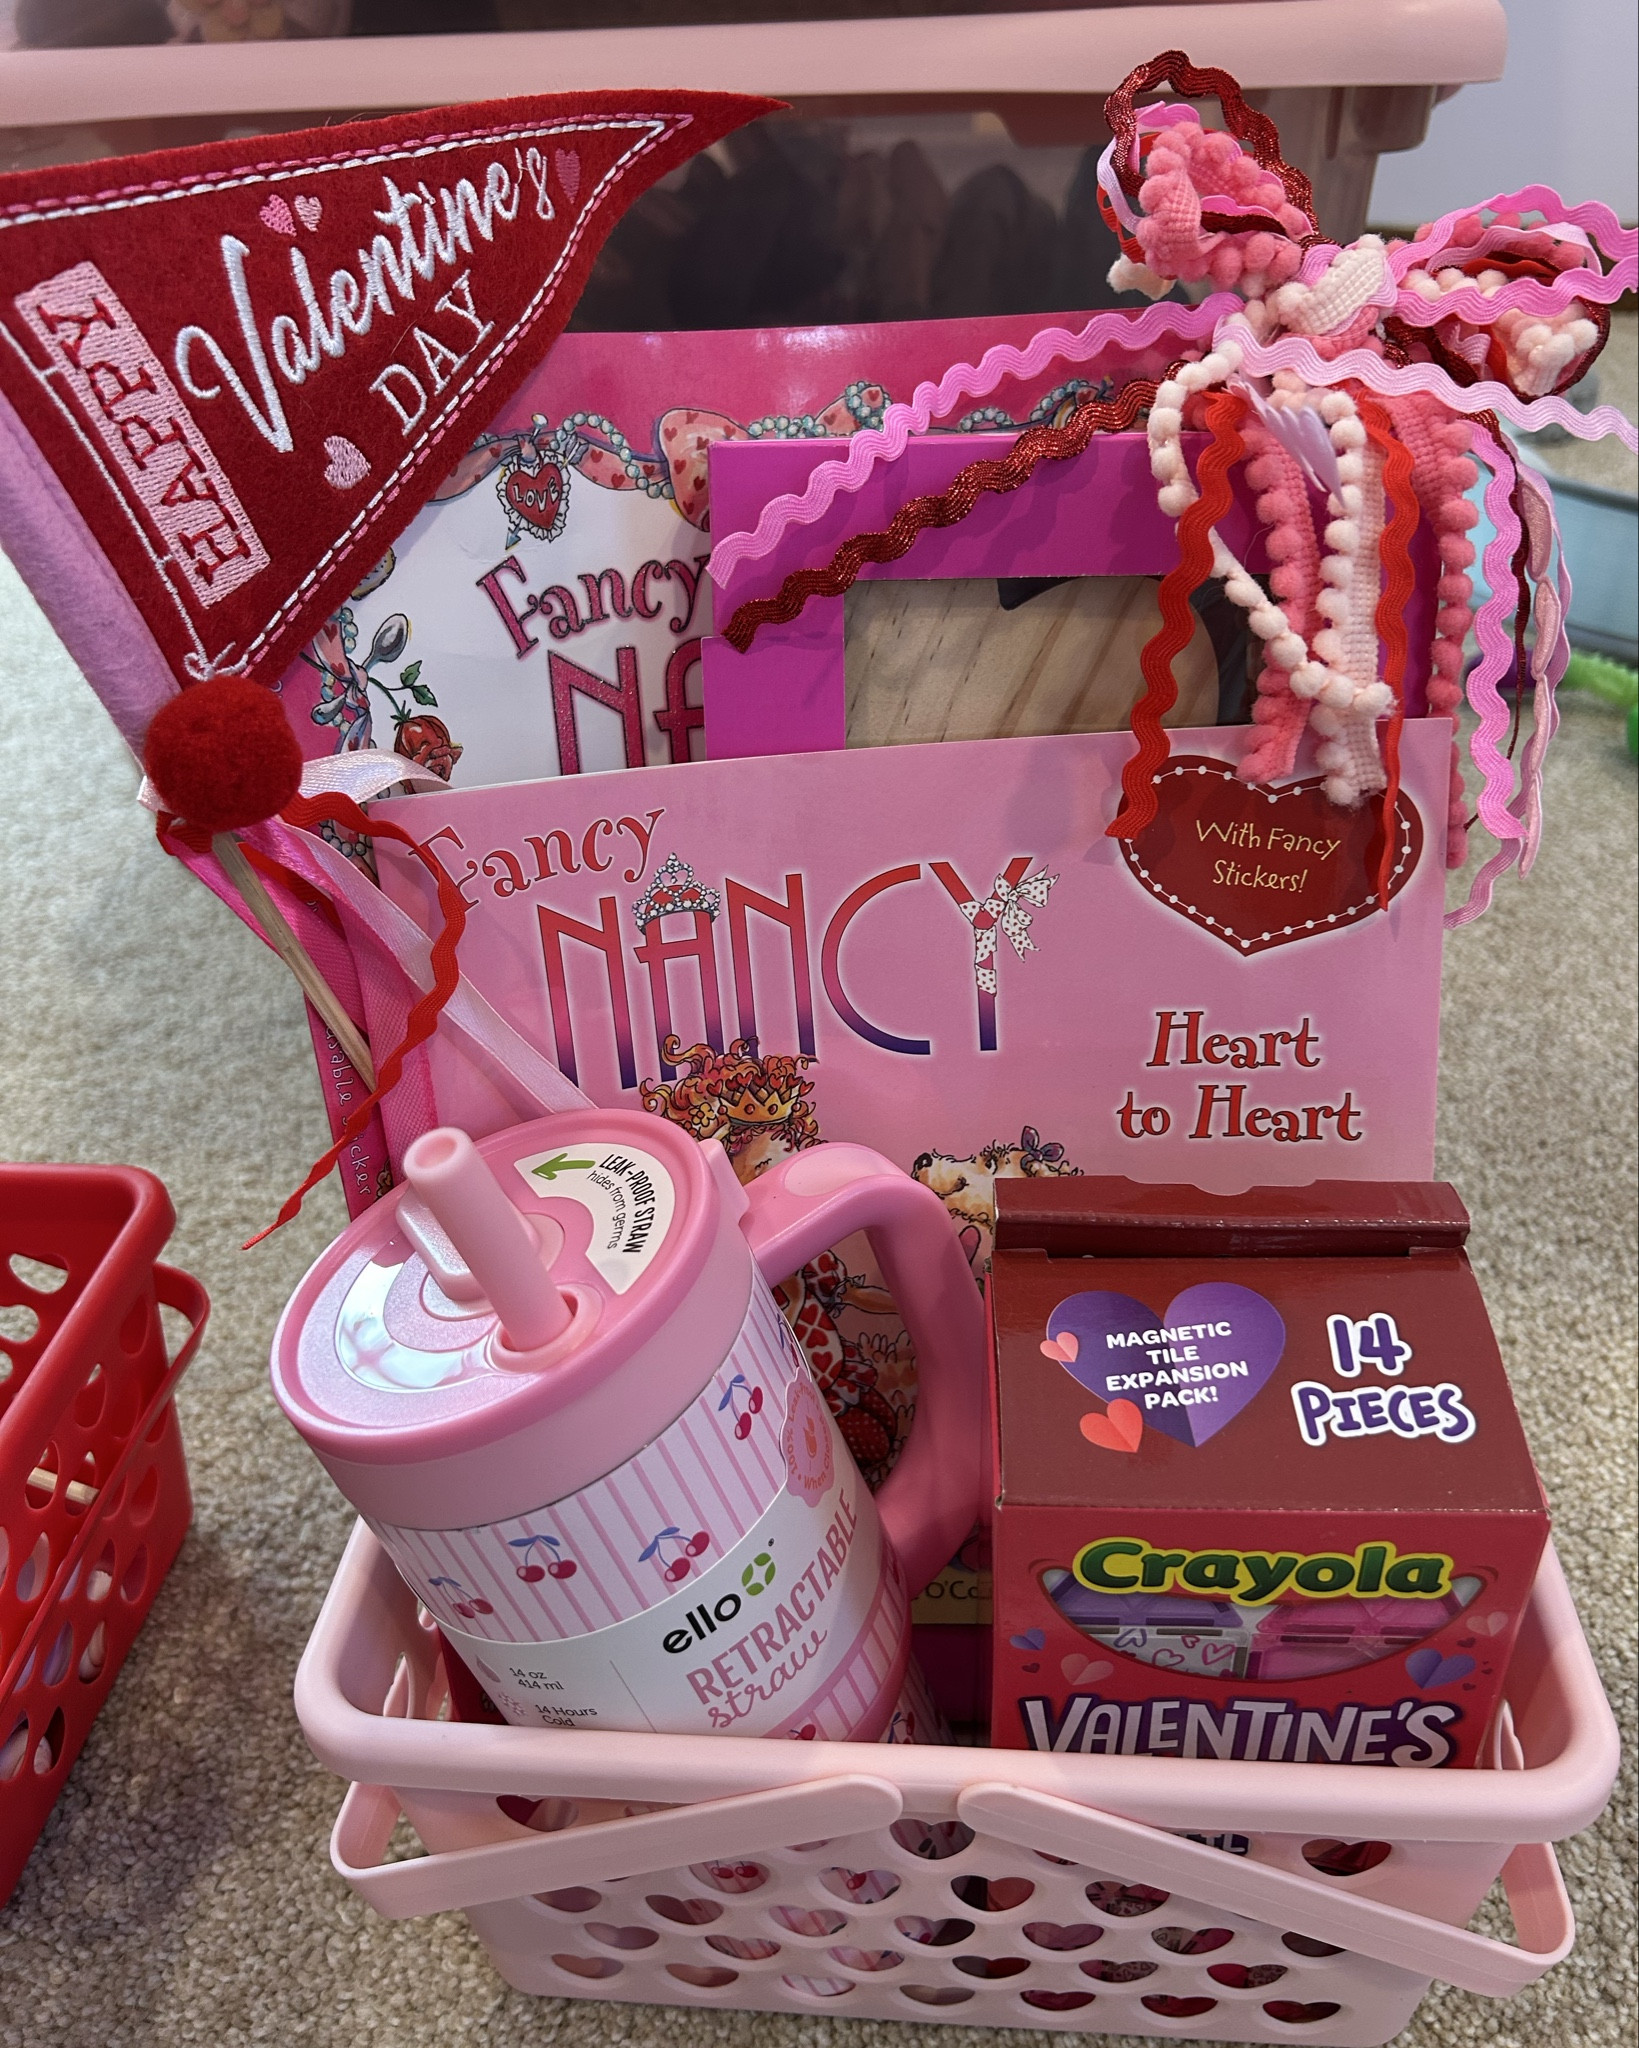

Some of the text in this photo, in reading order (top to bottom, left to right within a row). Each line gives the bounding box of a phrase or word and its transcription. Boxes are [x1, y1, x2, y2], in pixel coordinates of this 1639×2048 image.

[175, 146, 556, 454] Valentine's
[369, 269, 498, 438] DAY
[37, 296, 252, 586] HAPPY
[512, 477, 560, 513] LOVE
[475, 554, 711, 661] Fancy
[406, 808, 667, 913] Fancy
[1195, 818, 1342, 862] With Fancy
[1212, 859, 1310, 895] Stickers!
[536, 856, 1034, 1091] NANCY
[1146, 1010, 1321, 1069] Heart
[1116, 1083, 1364, 1143] to Heart
[586, 1169, 628, 1250] hides from germs
[598, 1153, 656, 1253] LEAK-PROOF STRAW
[1105, 1320, 1233, 1350] MAGNETIC
[1145, 1344, 1201, 1364] TILE
[1329, 1314, 1409, 1376] 14
[1105, 1360, 1250, 1392] EXPANSION
[1143, 1385, 1220, 1411] PACK!
[1294, 1383, 1473, 1443] PIECES
[685, 1487, 858, 1706] RETRACTABLE
[1077, 1538, 1449, 1604] Crayola
[662, 1592, 742, 1655] ello
[509, 1667, 547, 1679] 14 oz
[518, 1679, 564, 1690] 414 ml
[707, 1629, 828, 1729] straw
[535, 1704, 598, 1716] 14 Hours
[542, 1715, 576, 1726] Cold
